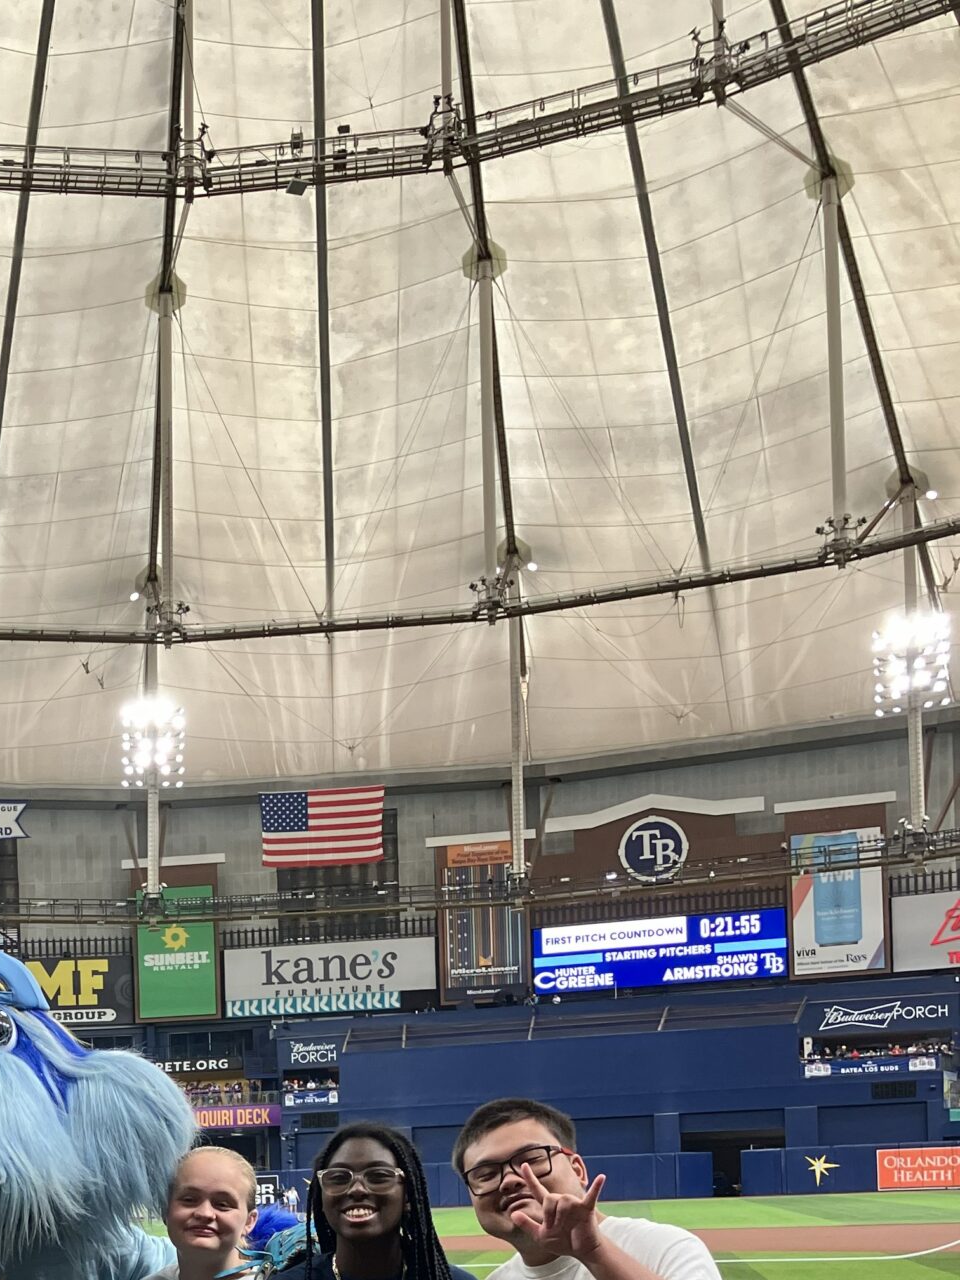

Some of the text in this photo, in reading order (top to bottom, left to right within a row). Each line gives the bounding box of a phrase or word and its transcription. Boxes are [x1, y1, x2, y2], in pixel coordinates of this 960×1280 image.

[632, 829, 679, 871] TB
[699, 914, 761, 938] 0:21:55
[545, 926, 684, 946] FIRST PITCH COUNTDOWN
[144, 951, 208, 967] SUNBELT
[604, 944, 712, 962] STARTING PITCHERS
[717, 953, 758, 965] SHAWN
[261, 949, 398, 986] kane's
[662, 961, 758, 981] ARMSTRONG
[760, 952, 784, 974] TB
[554, 966, 595, 977] HUNTER
[556, 973, 614, 989] GREENE
[275, 984, 385, 998] FURNITURE
[51, 1010, 107, 1021] GROUP
[828, 1004, 949, 1024] Budweiser PORCH
[293, 1043, 336, 1053] Budweiser
[291, 1050, 337, 1064] PORCH
[236, 1108, 271, 1125] DECK
[883, 1154, 960, 1169] ORLANDO
[894, 1169, 952, 1182] HEALTH
